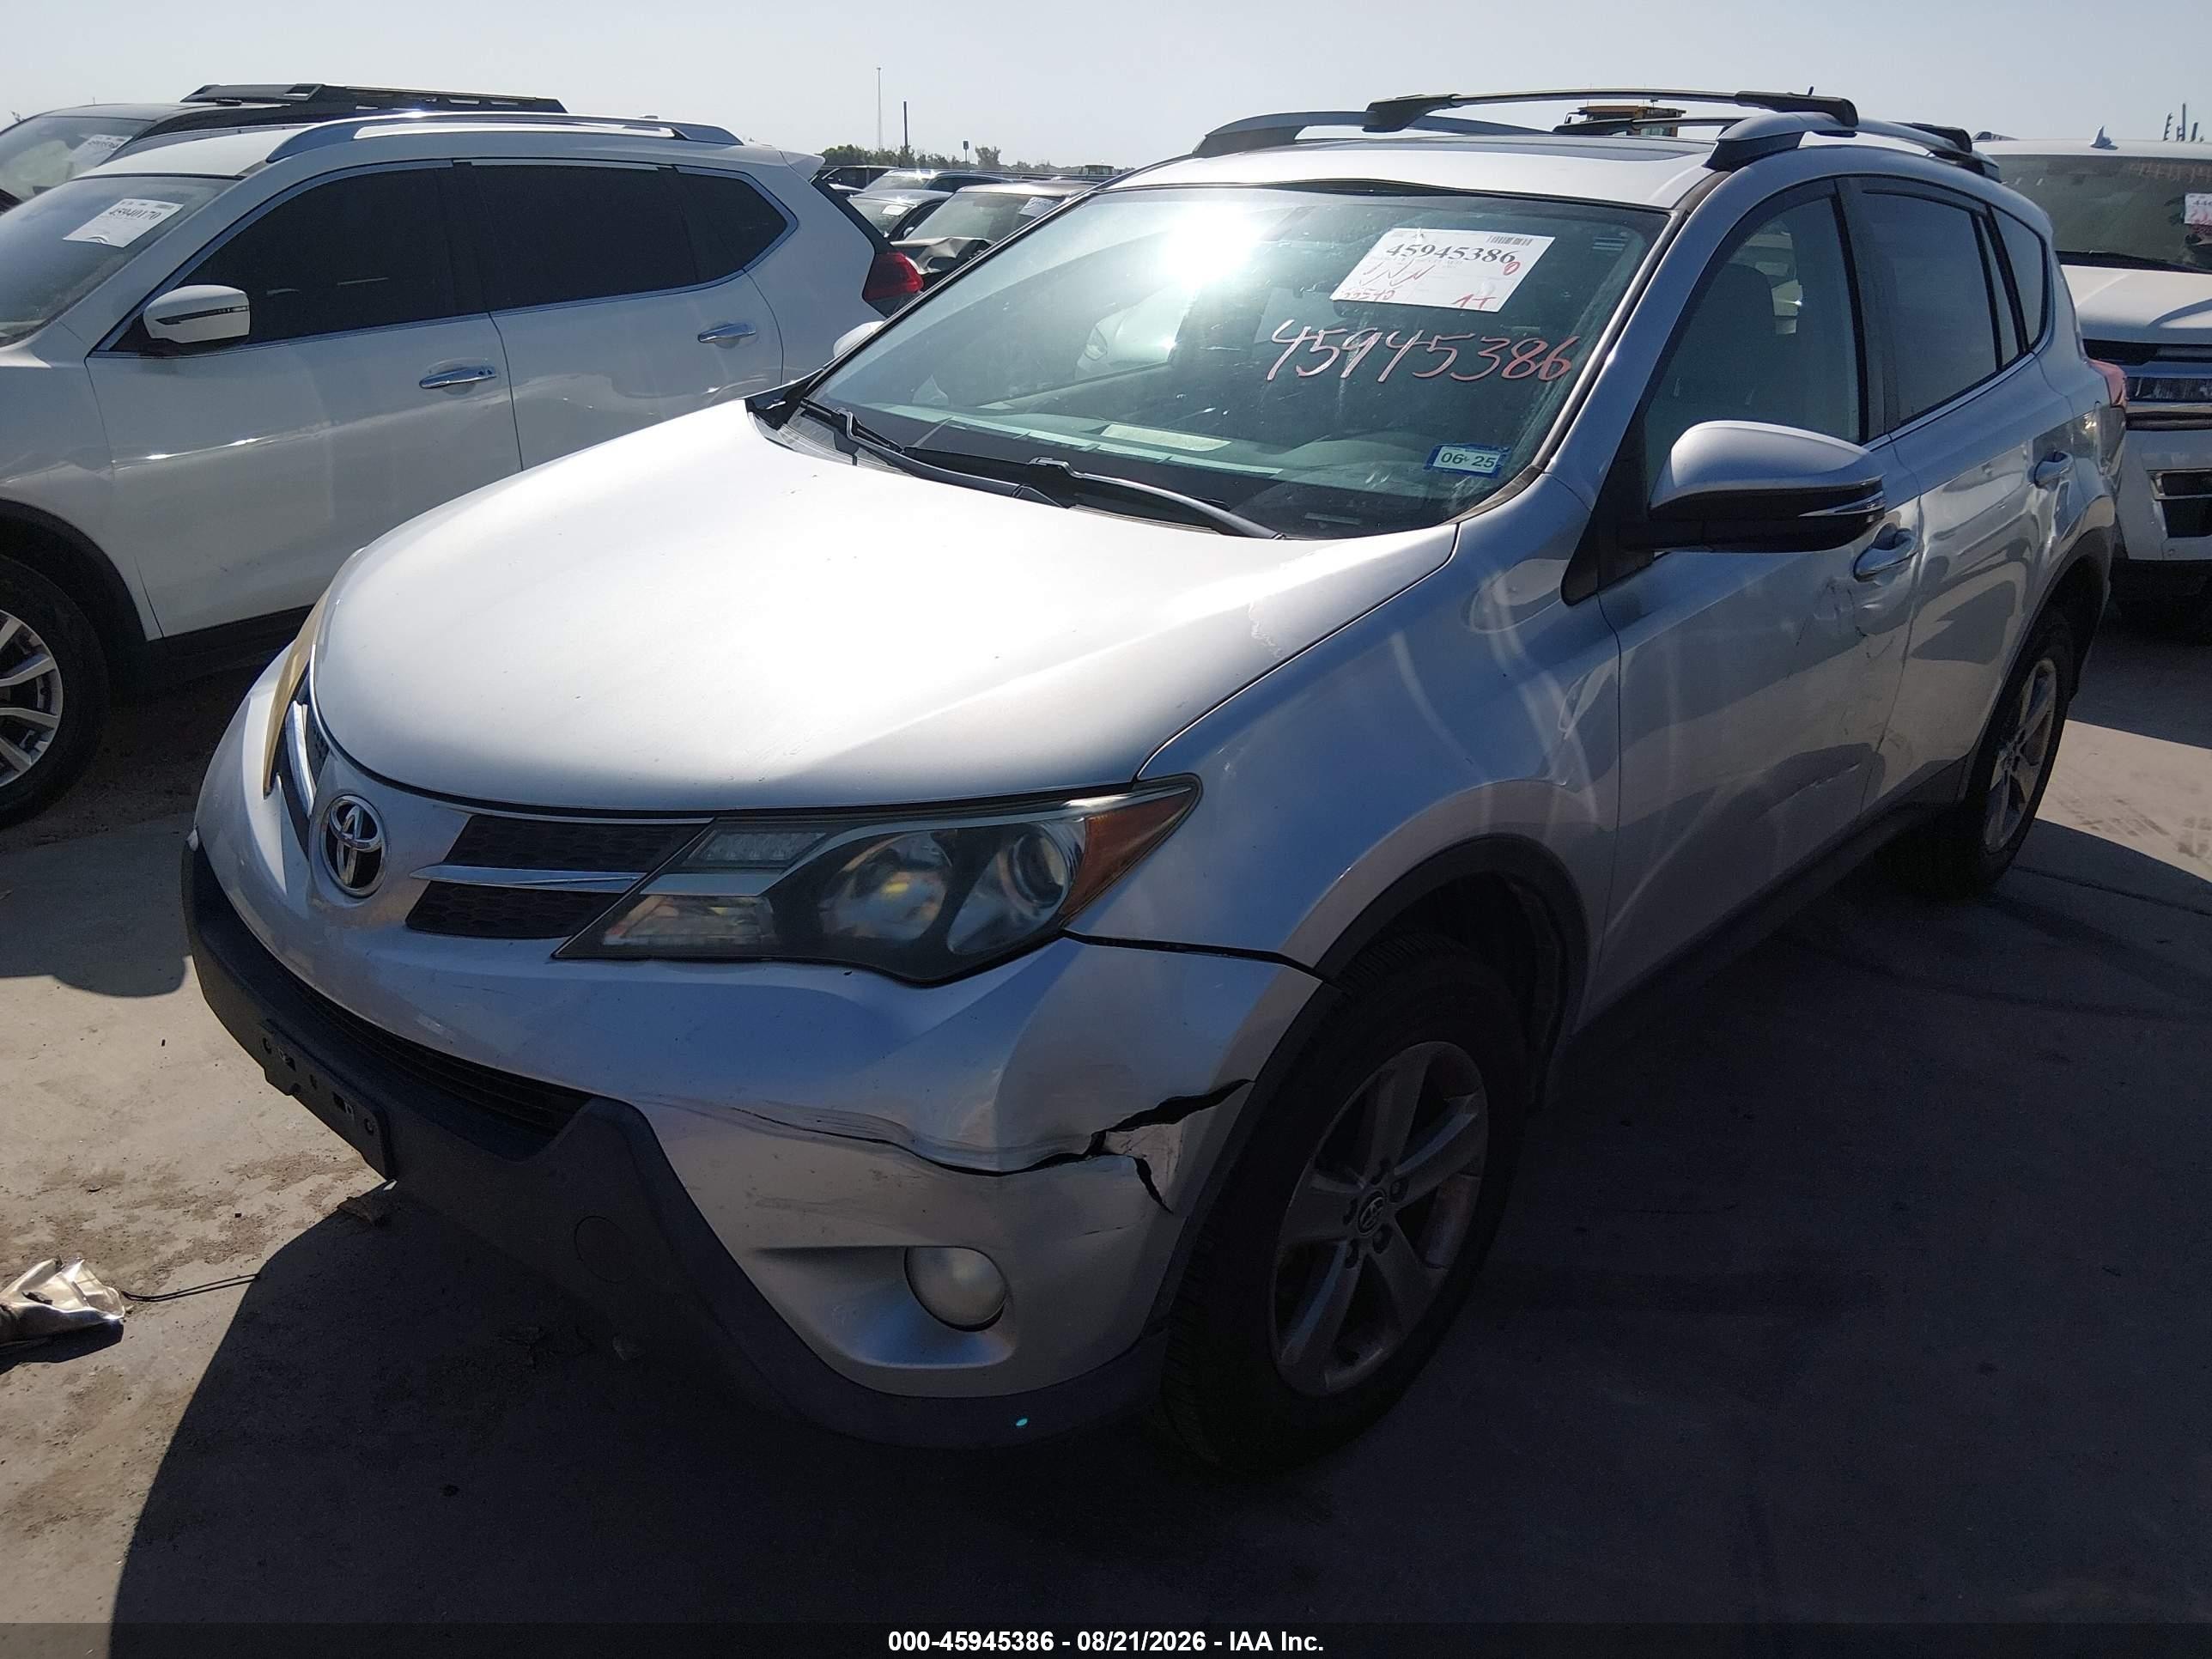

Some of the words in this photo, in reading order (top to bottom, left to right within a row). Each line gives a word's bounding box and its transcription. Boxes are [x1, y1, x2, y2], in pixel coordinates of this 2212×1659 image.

[1386, 243, 1519, 264] 45945386
[1267, 319, 1581, 382] 45945386
[1440, 453, 1465, 465] 06
[1471, 455, 1497, 468] 25
